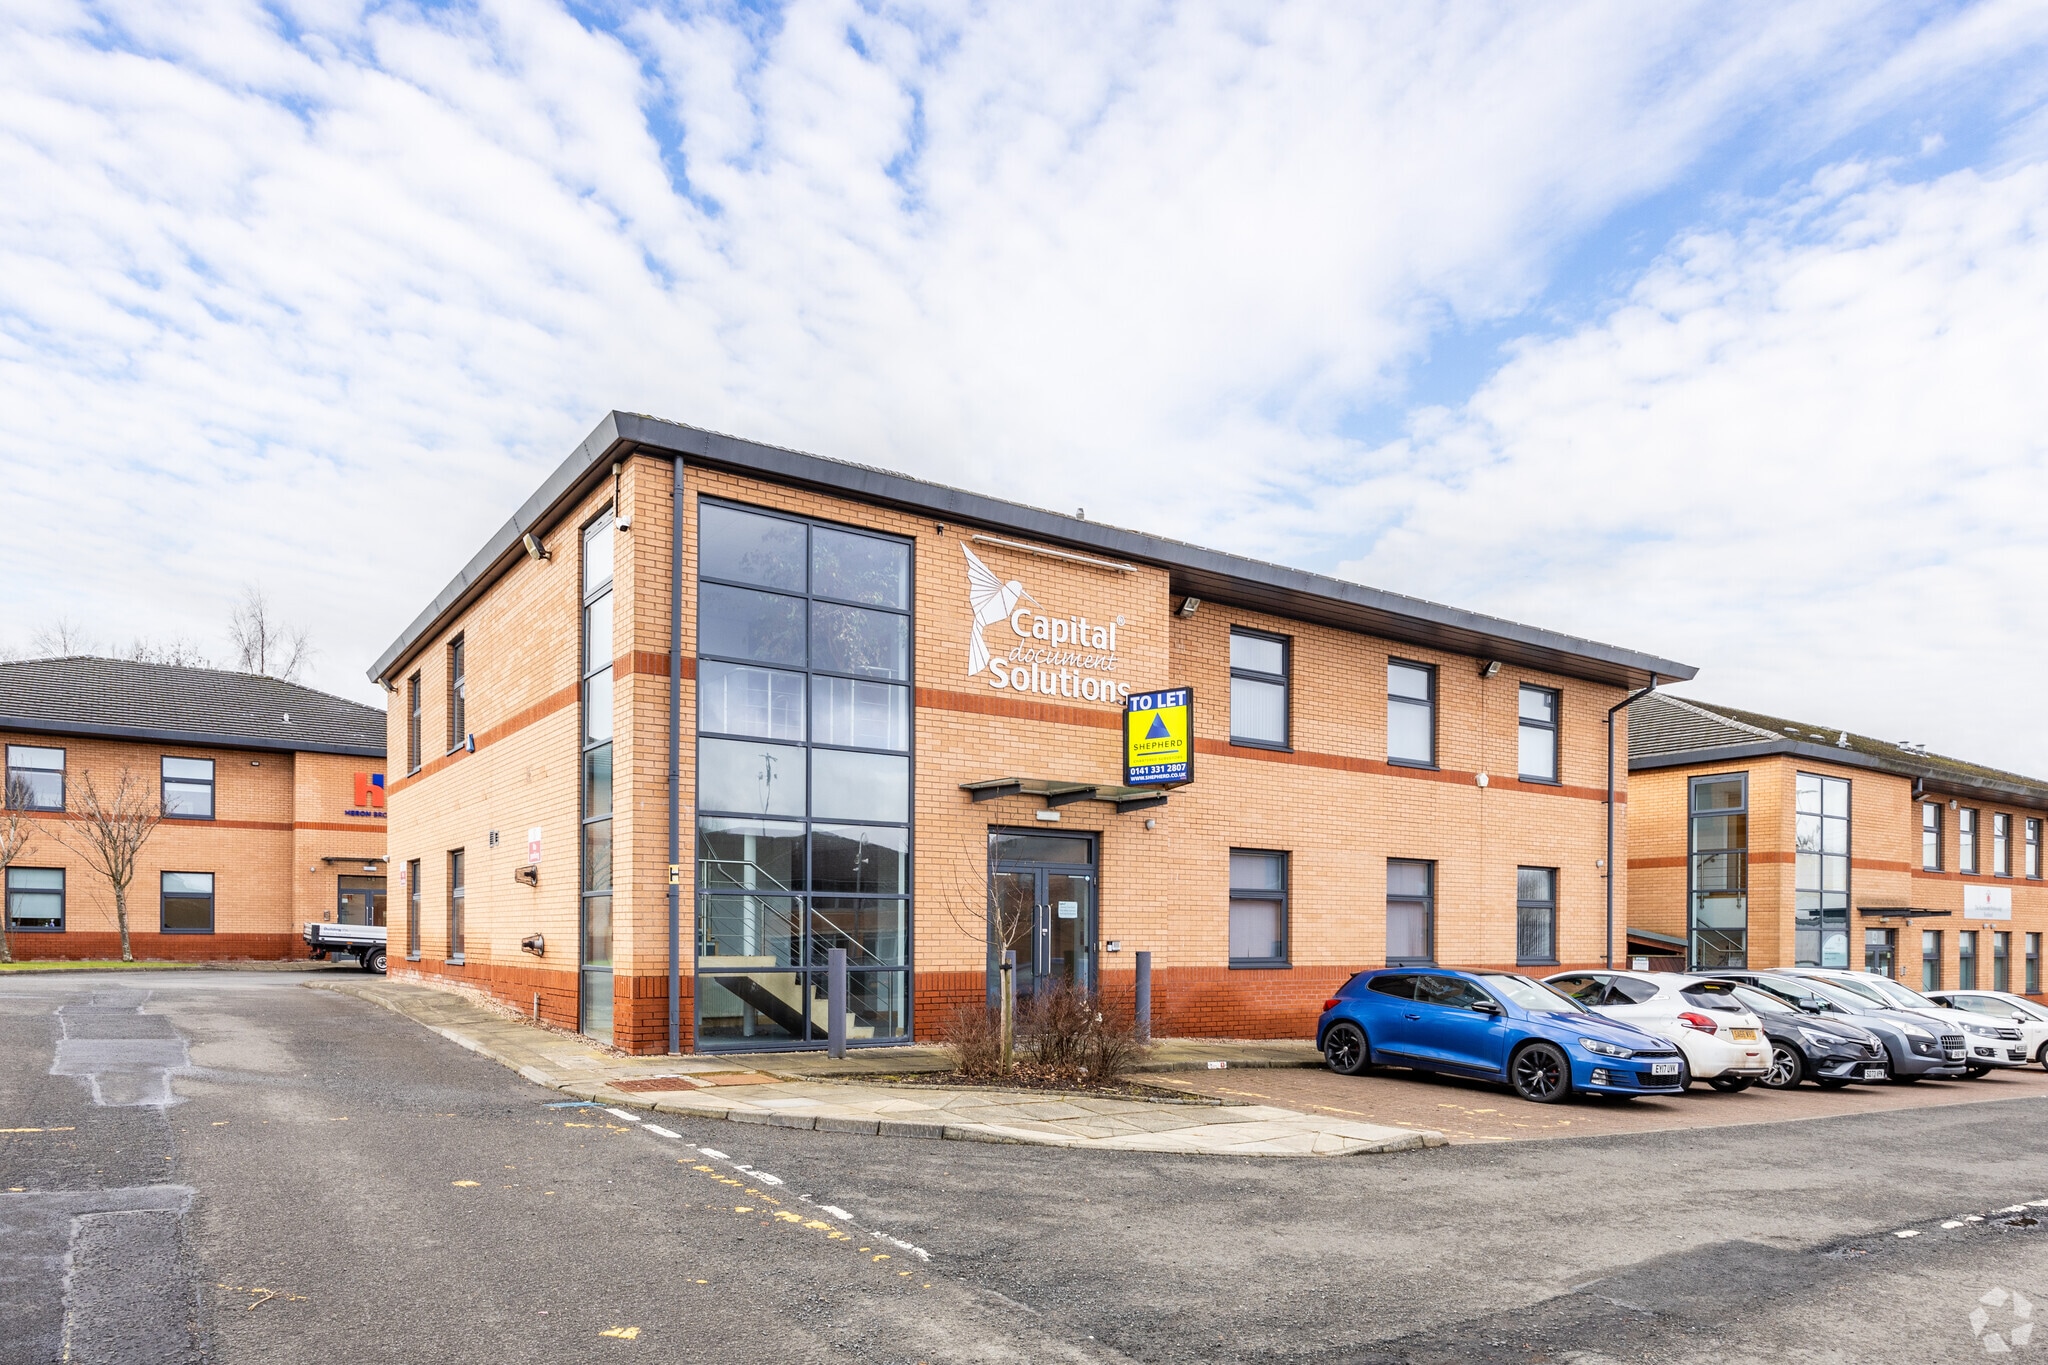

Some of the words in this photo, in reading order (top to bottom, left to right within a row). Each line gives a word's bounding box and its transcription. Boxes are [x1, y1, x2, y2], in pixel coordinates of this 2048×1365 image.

[1008, 637, 1118, 671] document
[988, 657, 1131, 705] Solutions
[1130, 695, 1152, 711] TO
[1157, 690, 1186, 708] LET
[1133, 739, 1183, 751] SHEPHERD
[1130, 767, 1149, 775] 0141
[1151, 765, 1165, 774] 331
[1167, 763, 1186, 772] 2807
[1130, 772, 1186, 781] WWW.SHEPHERD.CO.UK
[1655, 1064, 1666, 1073] EY17
